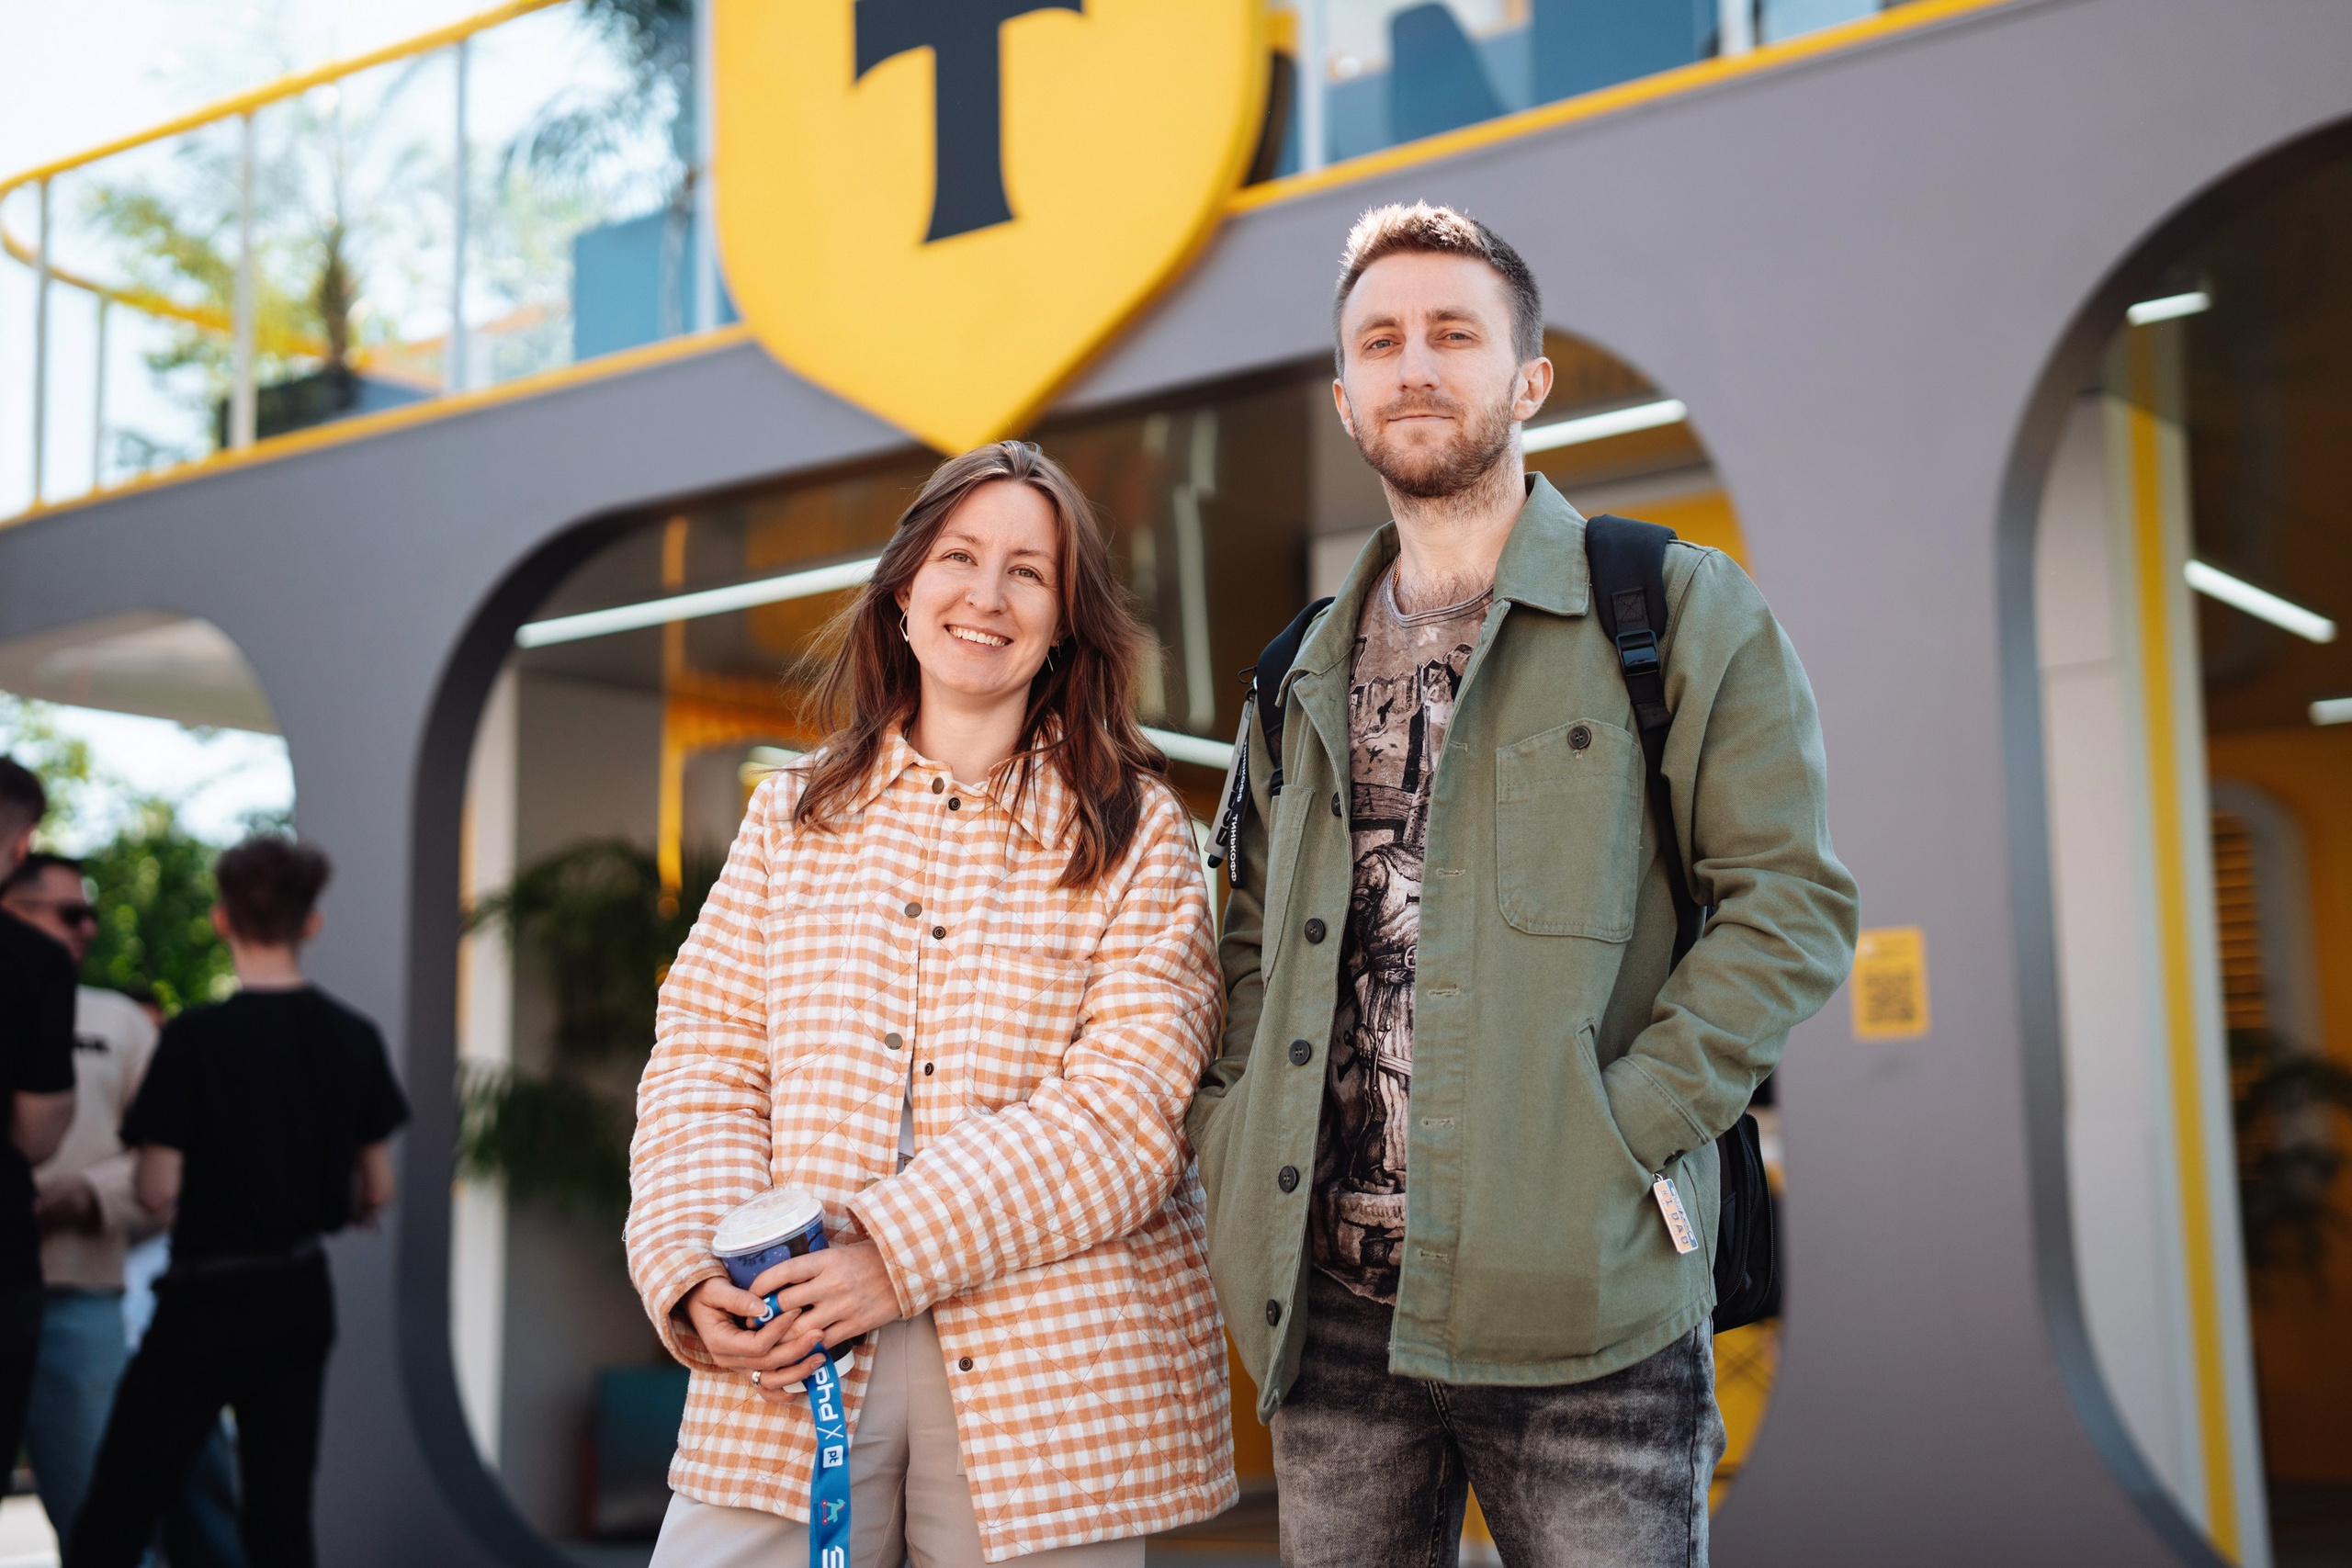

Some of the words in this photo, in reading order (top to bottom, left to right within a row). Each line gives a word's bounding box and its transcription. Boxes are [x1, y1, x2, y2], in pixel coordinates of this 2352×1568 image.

[854, 0, 1083, 244] T
[1237, 739, 1248, 803] ТИНЬКОФФ
[1229, 814, 1238, 883] ТИНЬКОФФ
[1671, 1212, 1689, 1245] DAD
[828, 1450, 840, 1463] pt
